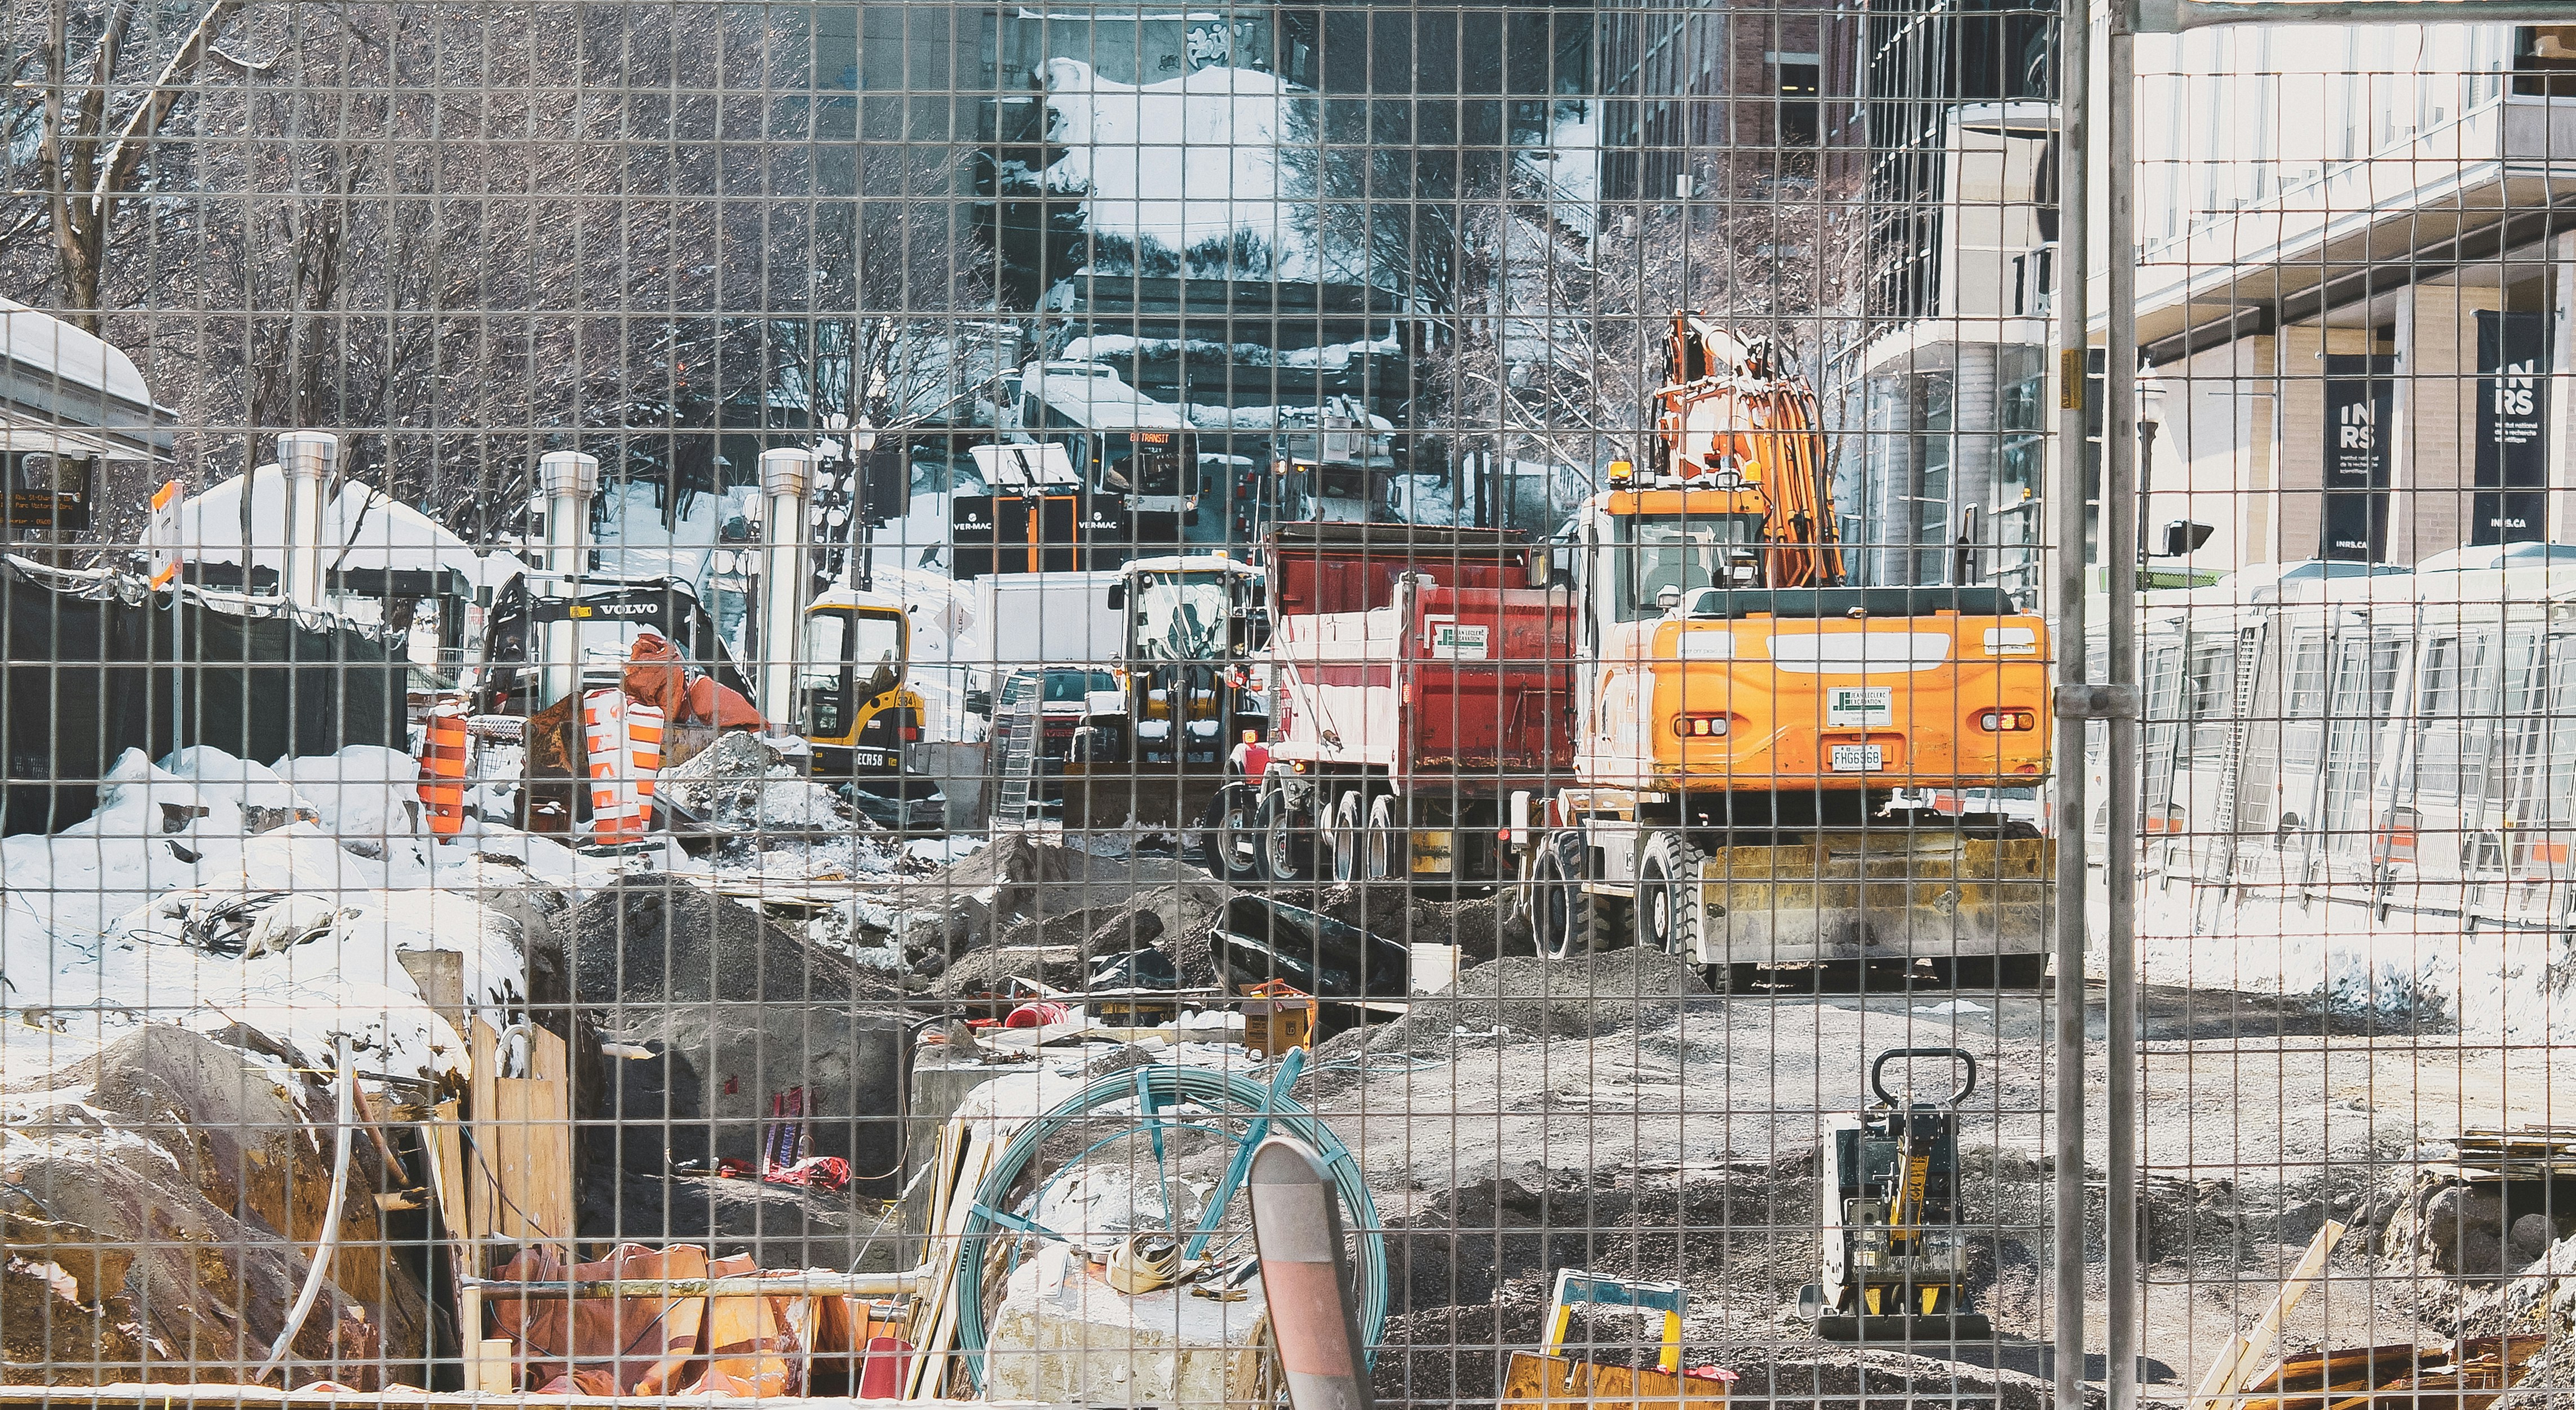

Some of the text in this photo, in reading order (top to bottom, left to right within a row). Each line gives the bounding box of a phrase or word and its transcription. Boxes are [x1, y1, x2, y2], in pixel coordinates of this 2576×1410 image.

[2495, 360, 2533, 388] IN
[2495, 389, 2533, 415] RS
[2342, 399, 2375, 425] IN
[1141, 433, 1169, 443] TRANSIT
[2341, 426, 2375, 449] RS
[600, 604, 658, 615] VOLVO
[857, 753, 883, 766] ECR58
[1835, 752, 1879, 764] FHG6968
